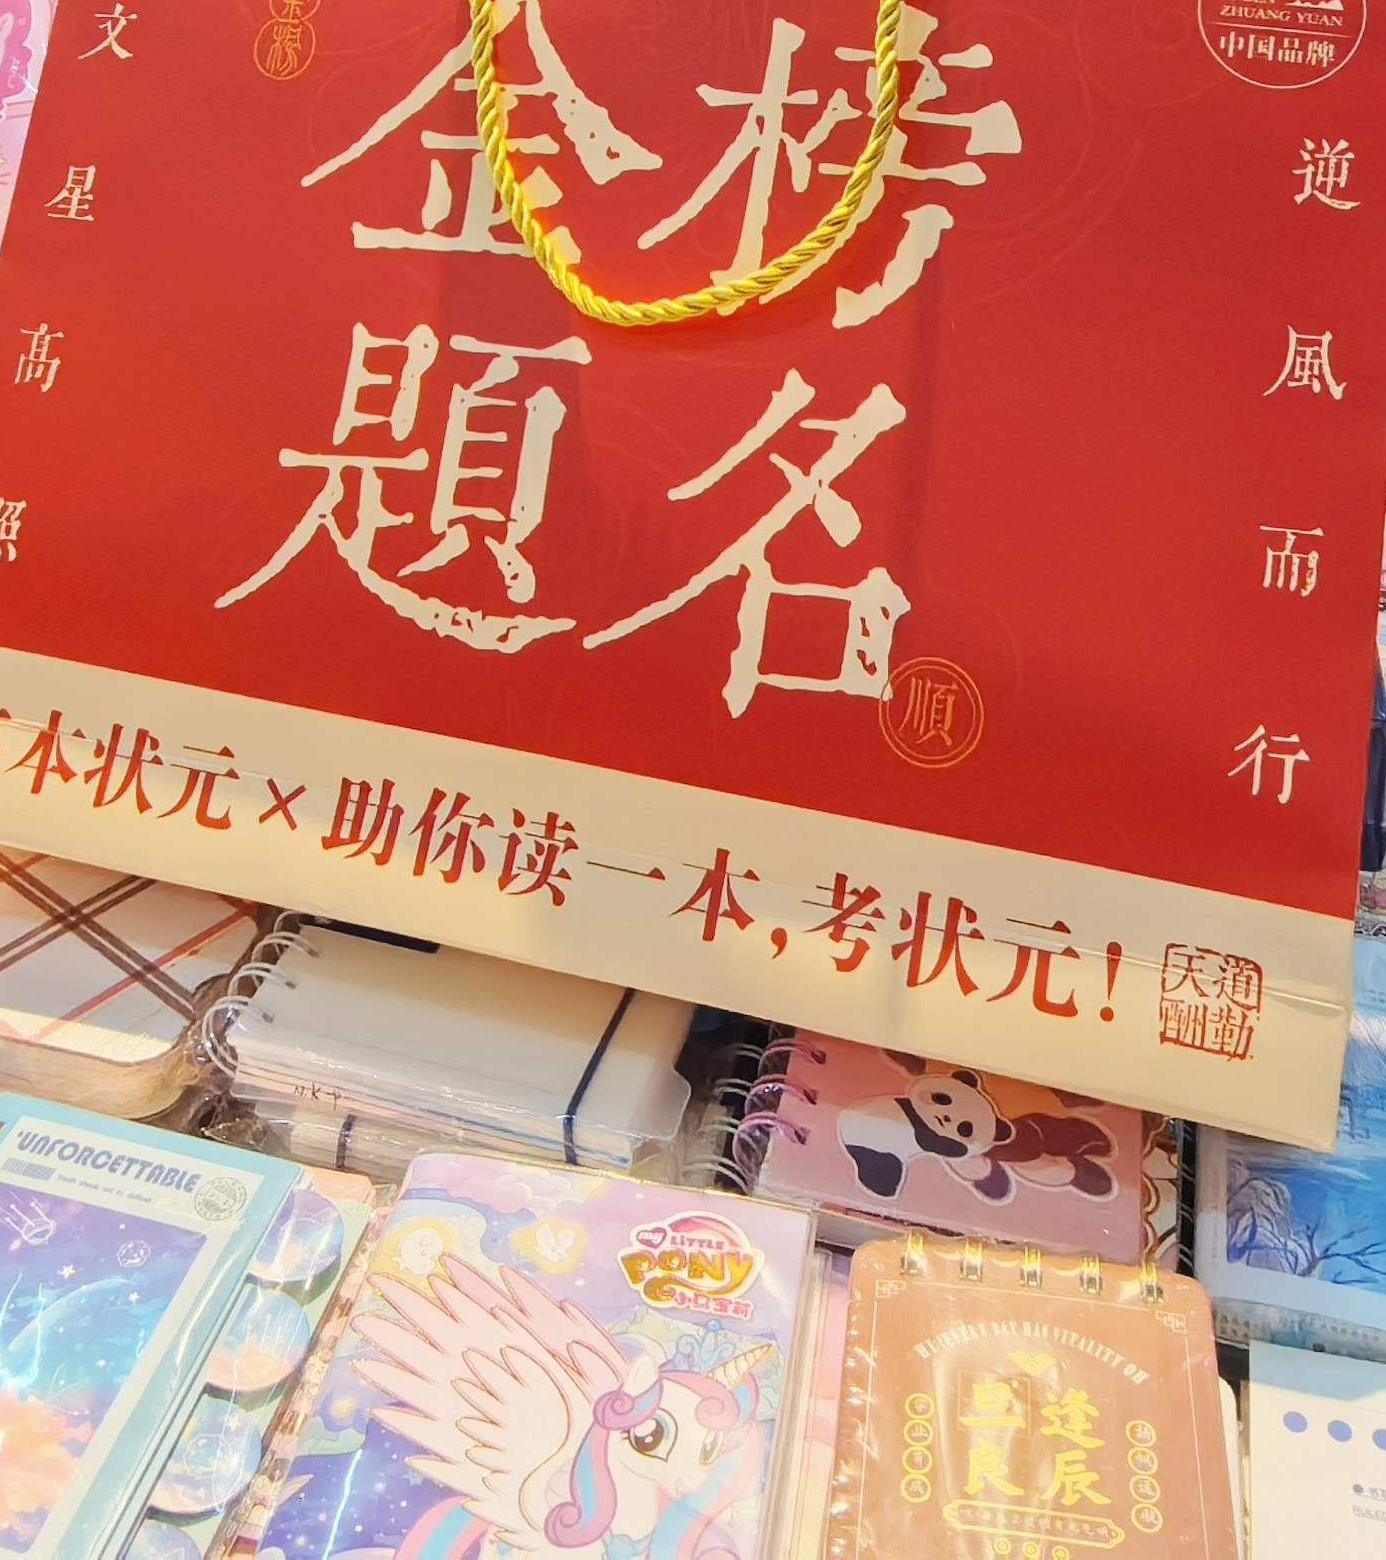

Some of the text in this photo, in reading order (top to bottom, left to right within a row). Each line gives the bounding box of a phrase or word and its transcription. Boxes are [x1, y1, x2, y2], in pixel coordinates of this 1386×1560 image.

[1219, 4, 1344, 27] ZHUANG YUAN
[1219, 31, 1336, 69] 中国品牌
[214, 322, 911, 718] 題名
[669, 1234, 726, 1250] LITTLE
[620, 1248, 755, 1287] PONY
[963, 1442, 1112, 1505] 良辰
